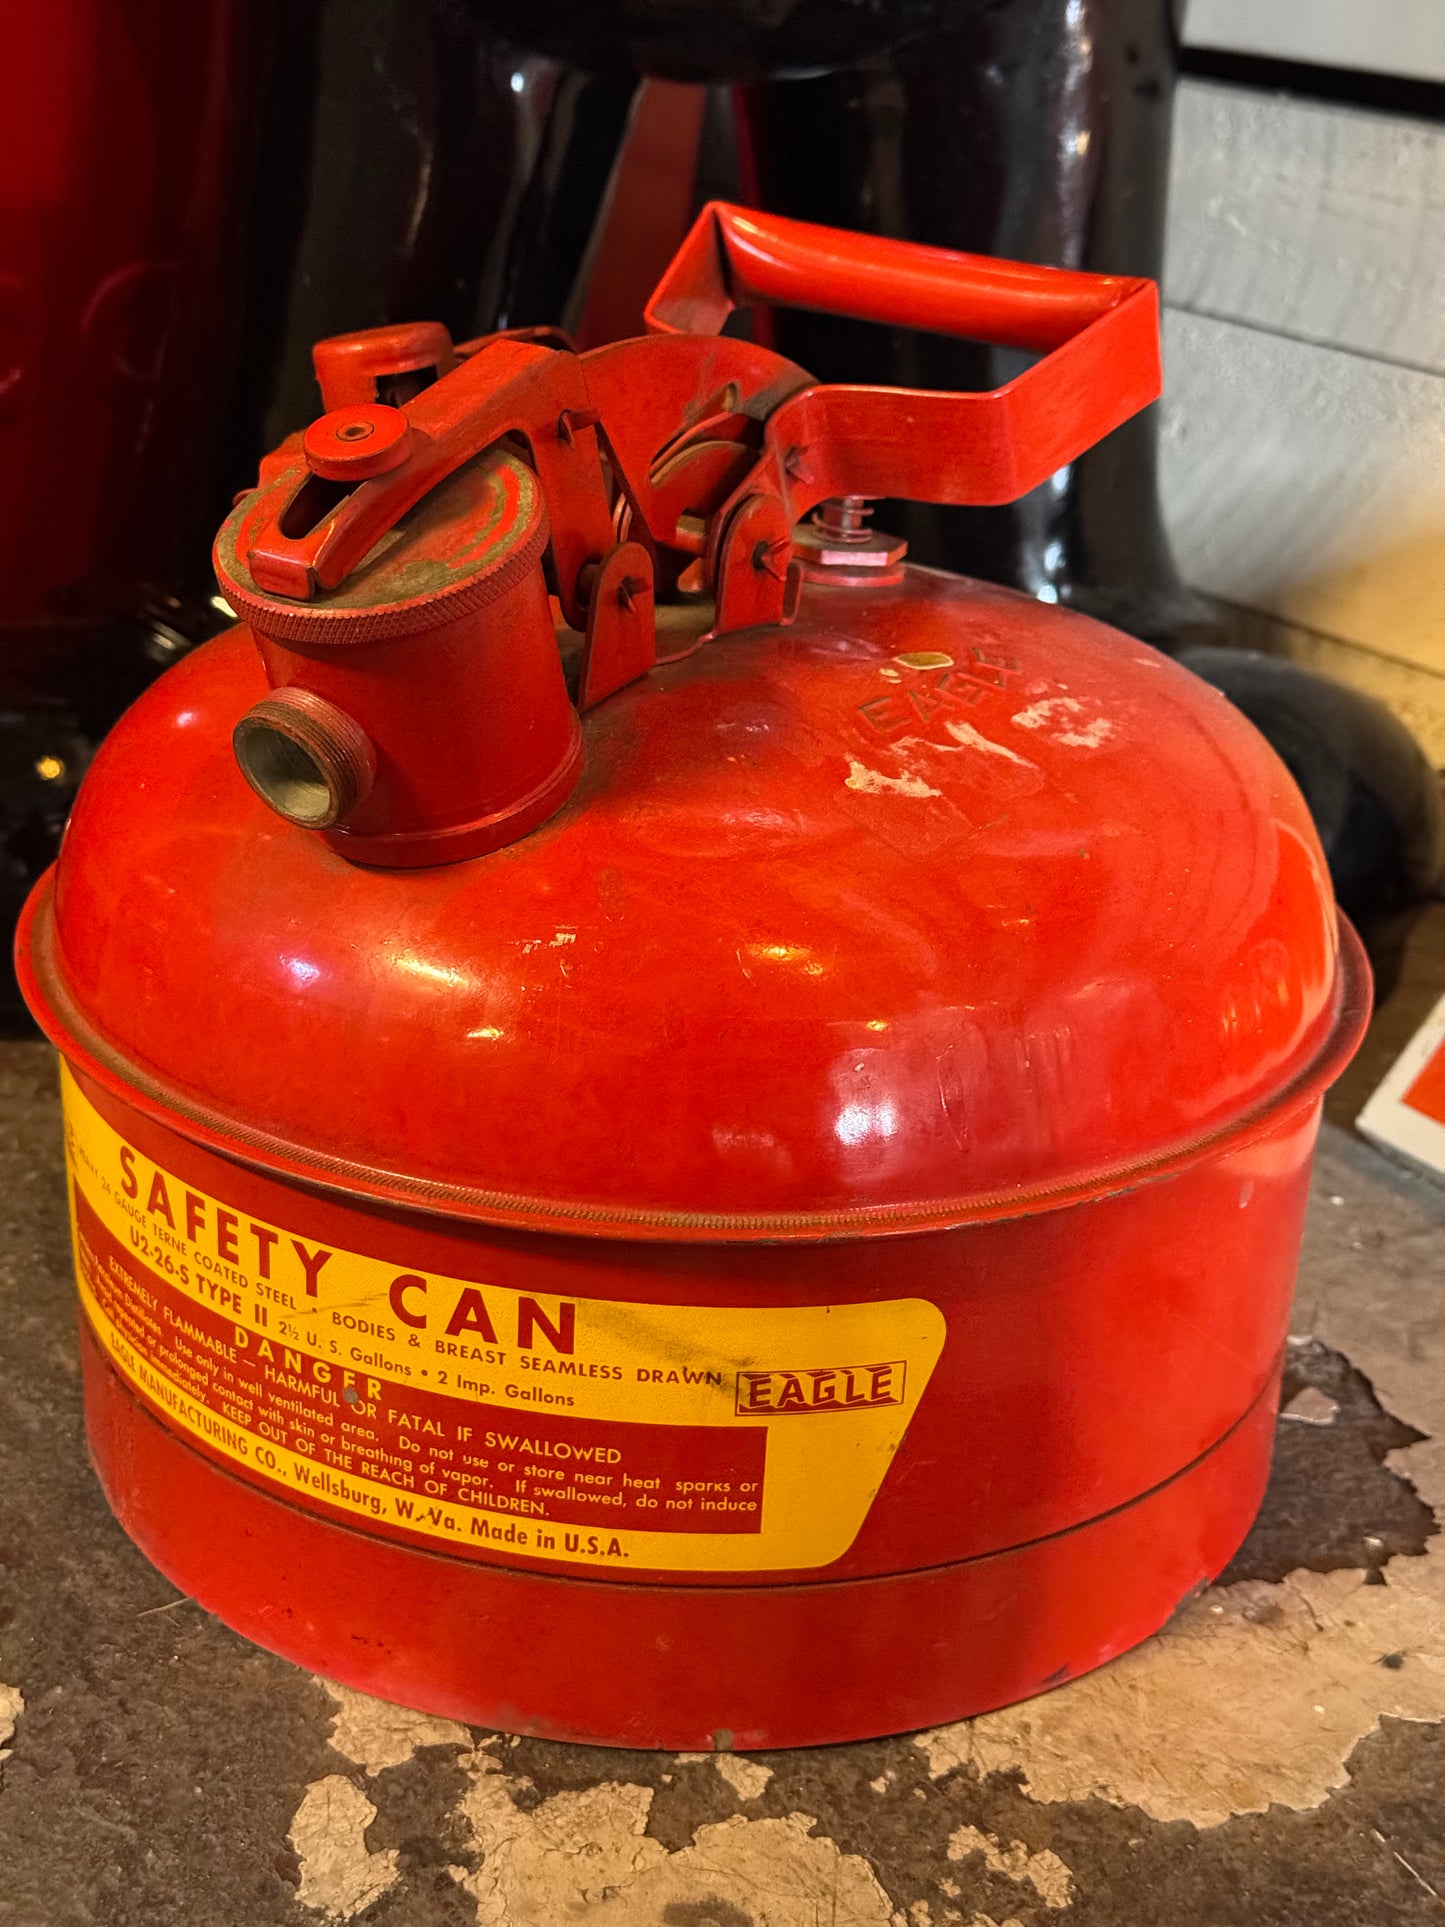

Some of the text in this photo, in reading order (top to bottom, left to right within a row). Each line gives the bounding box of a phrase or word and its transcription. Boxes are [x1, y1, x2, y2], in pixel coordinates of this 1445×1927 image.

[114, 1191, 147, 1228] GAUGE
[153, 1223, 187, 1256] TERNE
[194, 1252, 248, 1288] COATED
[256, 1282, 297, 1310] STEEL
[332, 1311, 396, 1342] BODIES
[435, 1340, 506, 1366] BREAST
[520, 1356, 623, 1380] SEAMLESS
[637, 1368, 722, 1385] DRAWN
[120, 1145, 333, 1298] SAFETY
[389, 1274, 576, 1355] CAN
[130, 1225, 189, 1285] U2-26-S
[196, 1273, 242, 1314] TYPE
[350, 1347, 412, 1376] Gallons
[438, 1371, 448, 1385] 2
[457, 1374, 496, 1396] Imp.
[505, 1384, 575, 1406] Gallons
[109, 1256, 158, 1311] EXTREMELY
[164, 1306, 237, 1364] FLAMMABLE
[265, 1364, 340, 1407] HARMFUL
[351, 1400, 377, 1419] OR
[388, 1408, 446, 1437] FATAL
[458, 1426, 473, 1442] IF
[485, 1432, 622, 1464] SWALLOWED
[110, 1331, 136, 1373] EAGLE
[139, 1363, 248, 1456] MANUFACTURING
[255, 1446, 287, 1477] CO.,
[294, 1462, 388, 1515] Wellsburg,
[470, 1516, 528, 1545] Made
[536, 1528, 555, 1550] in
[564, 1532, 630, 1558] U.S.A.
[160, 1345, 208, 1386] prolonged
[212, 1382, 253, 1410] contact
[258, 1406, 284, 1425] with
[290, 1418, 315, 1438] skin
[320, 1432, 335, 1445] or
[342, 1436, 413, 1472] breathing
[420, 1462, 435, 1475] of
[442, 1468, 494, 1489] vapor.
[516, 1480, 526, 1494] If
[534, 1486, 627, 1508] swallowed,
[636, 1494, 658, 1508] do
[666, 1498, 694, 1510] not
[701, 1496, 758, 1511] induce
[175, 1336, 193, 1358] Use
[196, 1354, 219, 1377] only
[224, 1366, 234, 1383] in
[239, 1377, 262, 1398] well
[268, 1392, 334, 1426] ventilated
[342, 1421, 380, 1442] area.
[400, 1435, 421, 1452] Do
[429, 1446, 454, 1461] not
[463, 1454, 489, 1468] use
[498, 1460, 515, 1472] or
[524, 1465, 565, 1480] store
[574, 1473, 613, 1486] near
[623, 1472, 660, 1490] heat
[676, 1480, 731, 1494] sparks
[740, 1482, 758, 1492] or
[235, 1326, 382, 1400] DANGER
[741, 1365, 894, 1409] EAGLE
[222, 1402, 252, 1426] KEEP
[259, 1422, 288, 1444] OUT
[296, 1438, 316, 1456] OF
[325, 1448, 352, 1470] THE
[362, 1461, 414, 1488] REACH
[424, 1480, 447, 1496] OF
[458, 1488, 550, 1516] CHILDREN.
